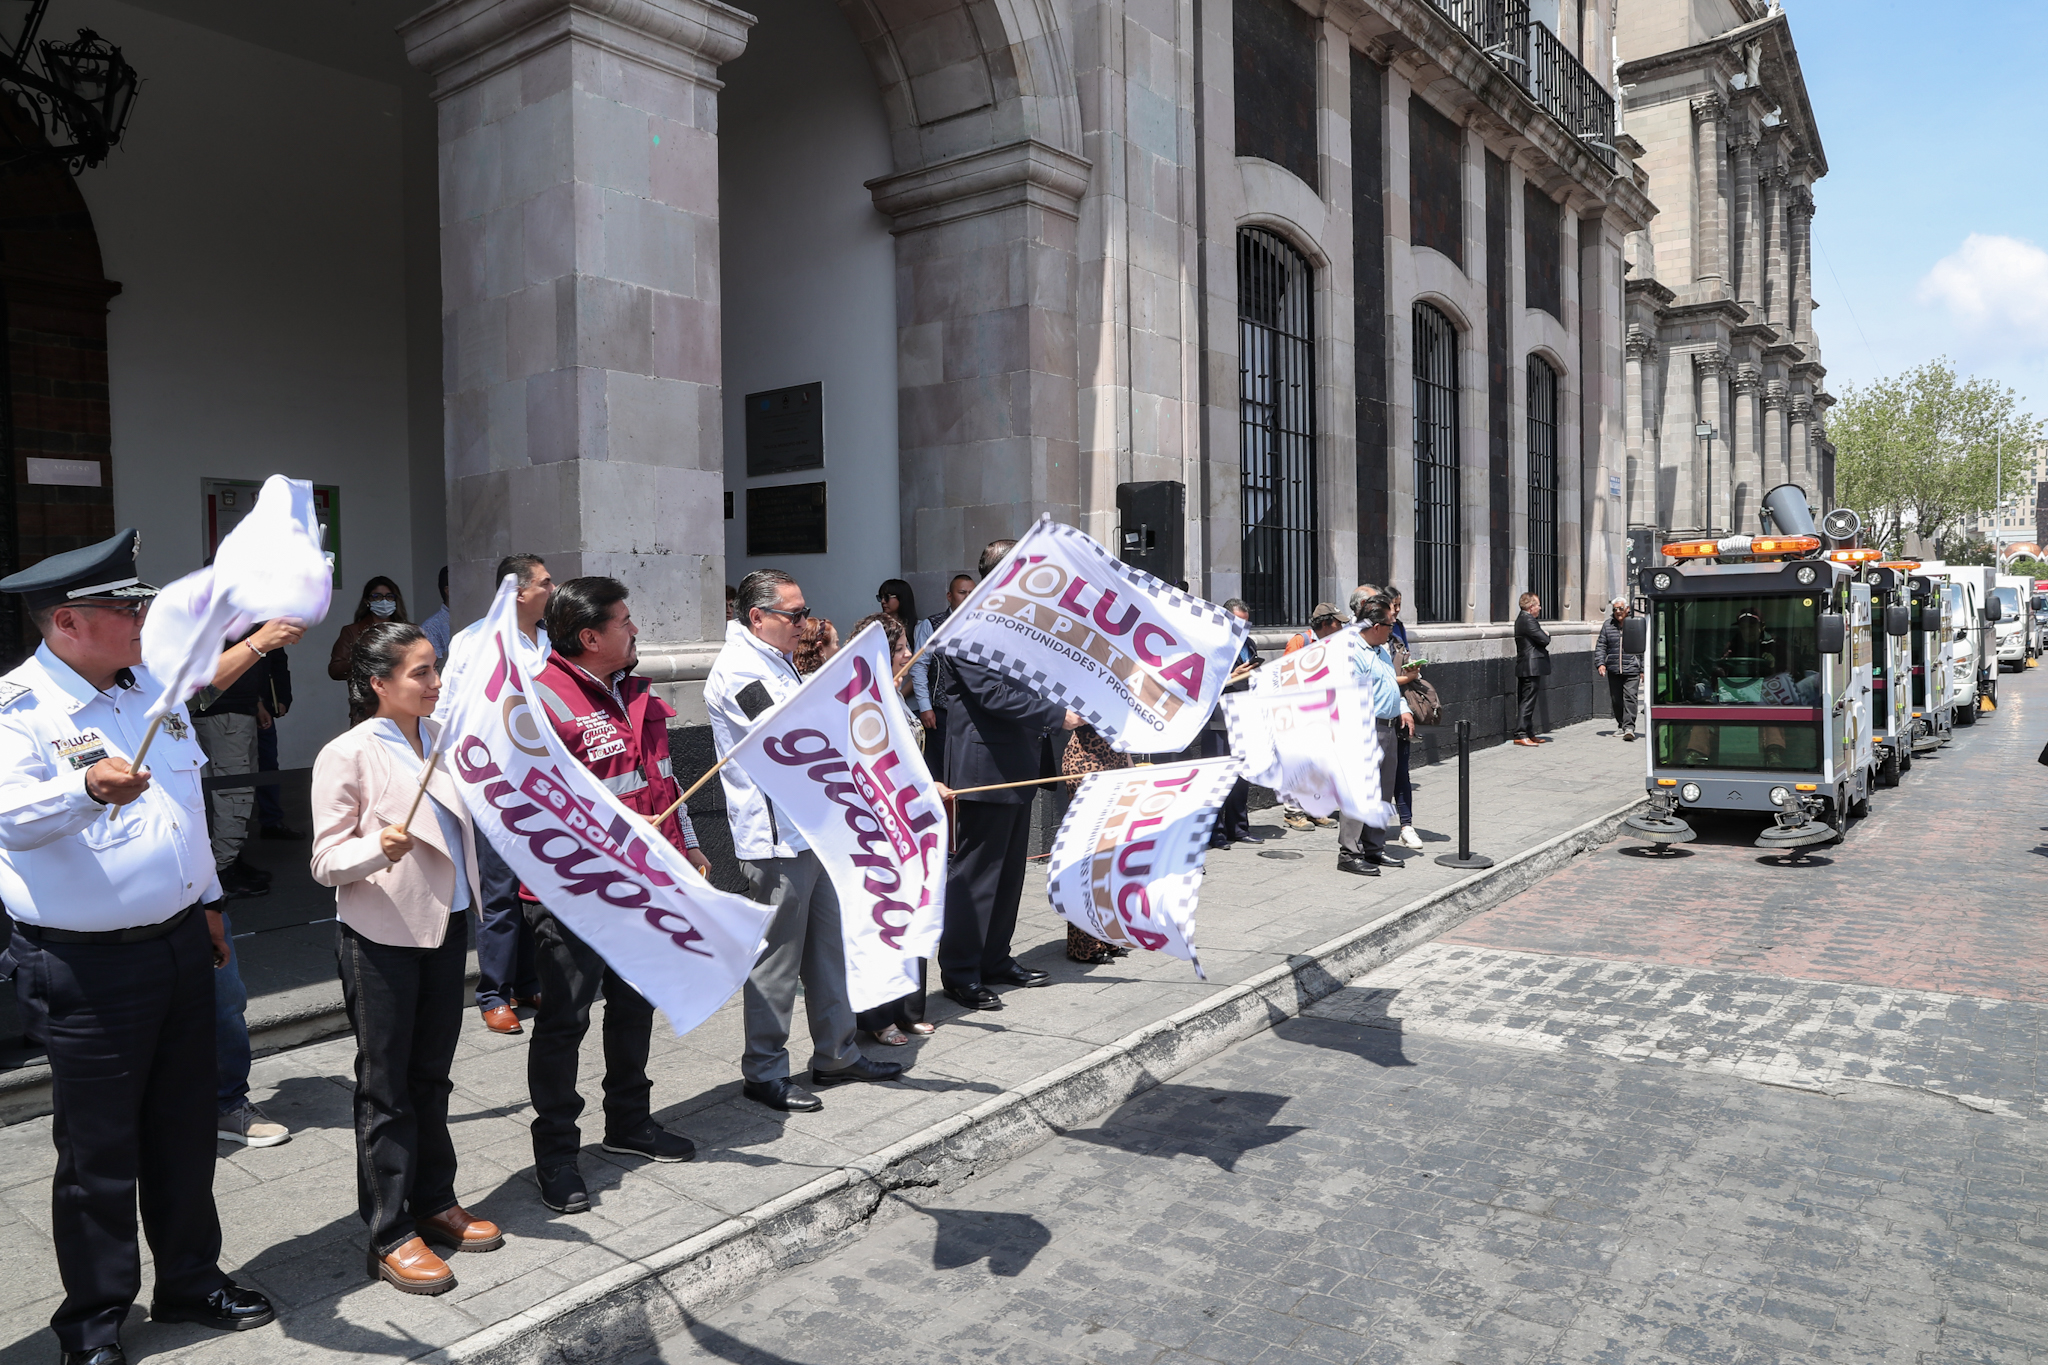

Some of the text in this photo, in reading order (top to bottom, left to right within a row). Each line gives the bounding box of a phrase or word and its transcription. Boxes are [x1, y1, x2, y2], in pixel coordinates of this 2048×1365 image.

[965, 610, 1165, 732] DE OPORTUNIDADES Y PROGRESO
[981, 594, 1177, 717] CAPITAL
[994, 555, 1206, 702] TOLUCA
[51, 731, 100, 750] TOLUCA
[583, 724, 617, 746] guapa
[590, 743, 625, 759] TOLUCA
[455, 734, 715, 959] guapa
[531, 778, 632, 860] se pon
[763, 728, 915, 951] guapa
[855, 771, 912, 858] se pone
[1118, 768, 1199, 951] TOLUCA
